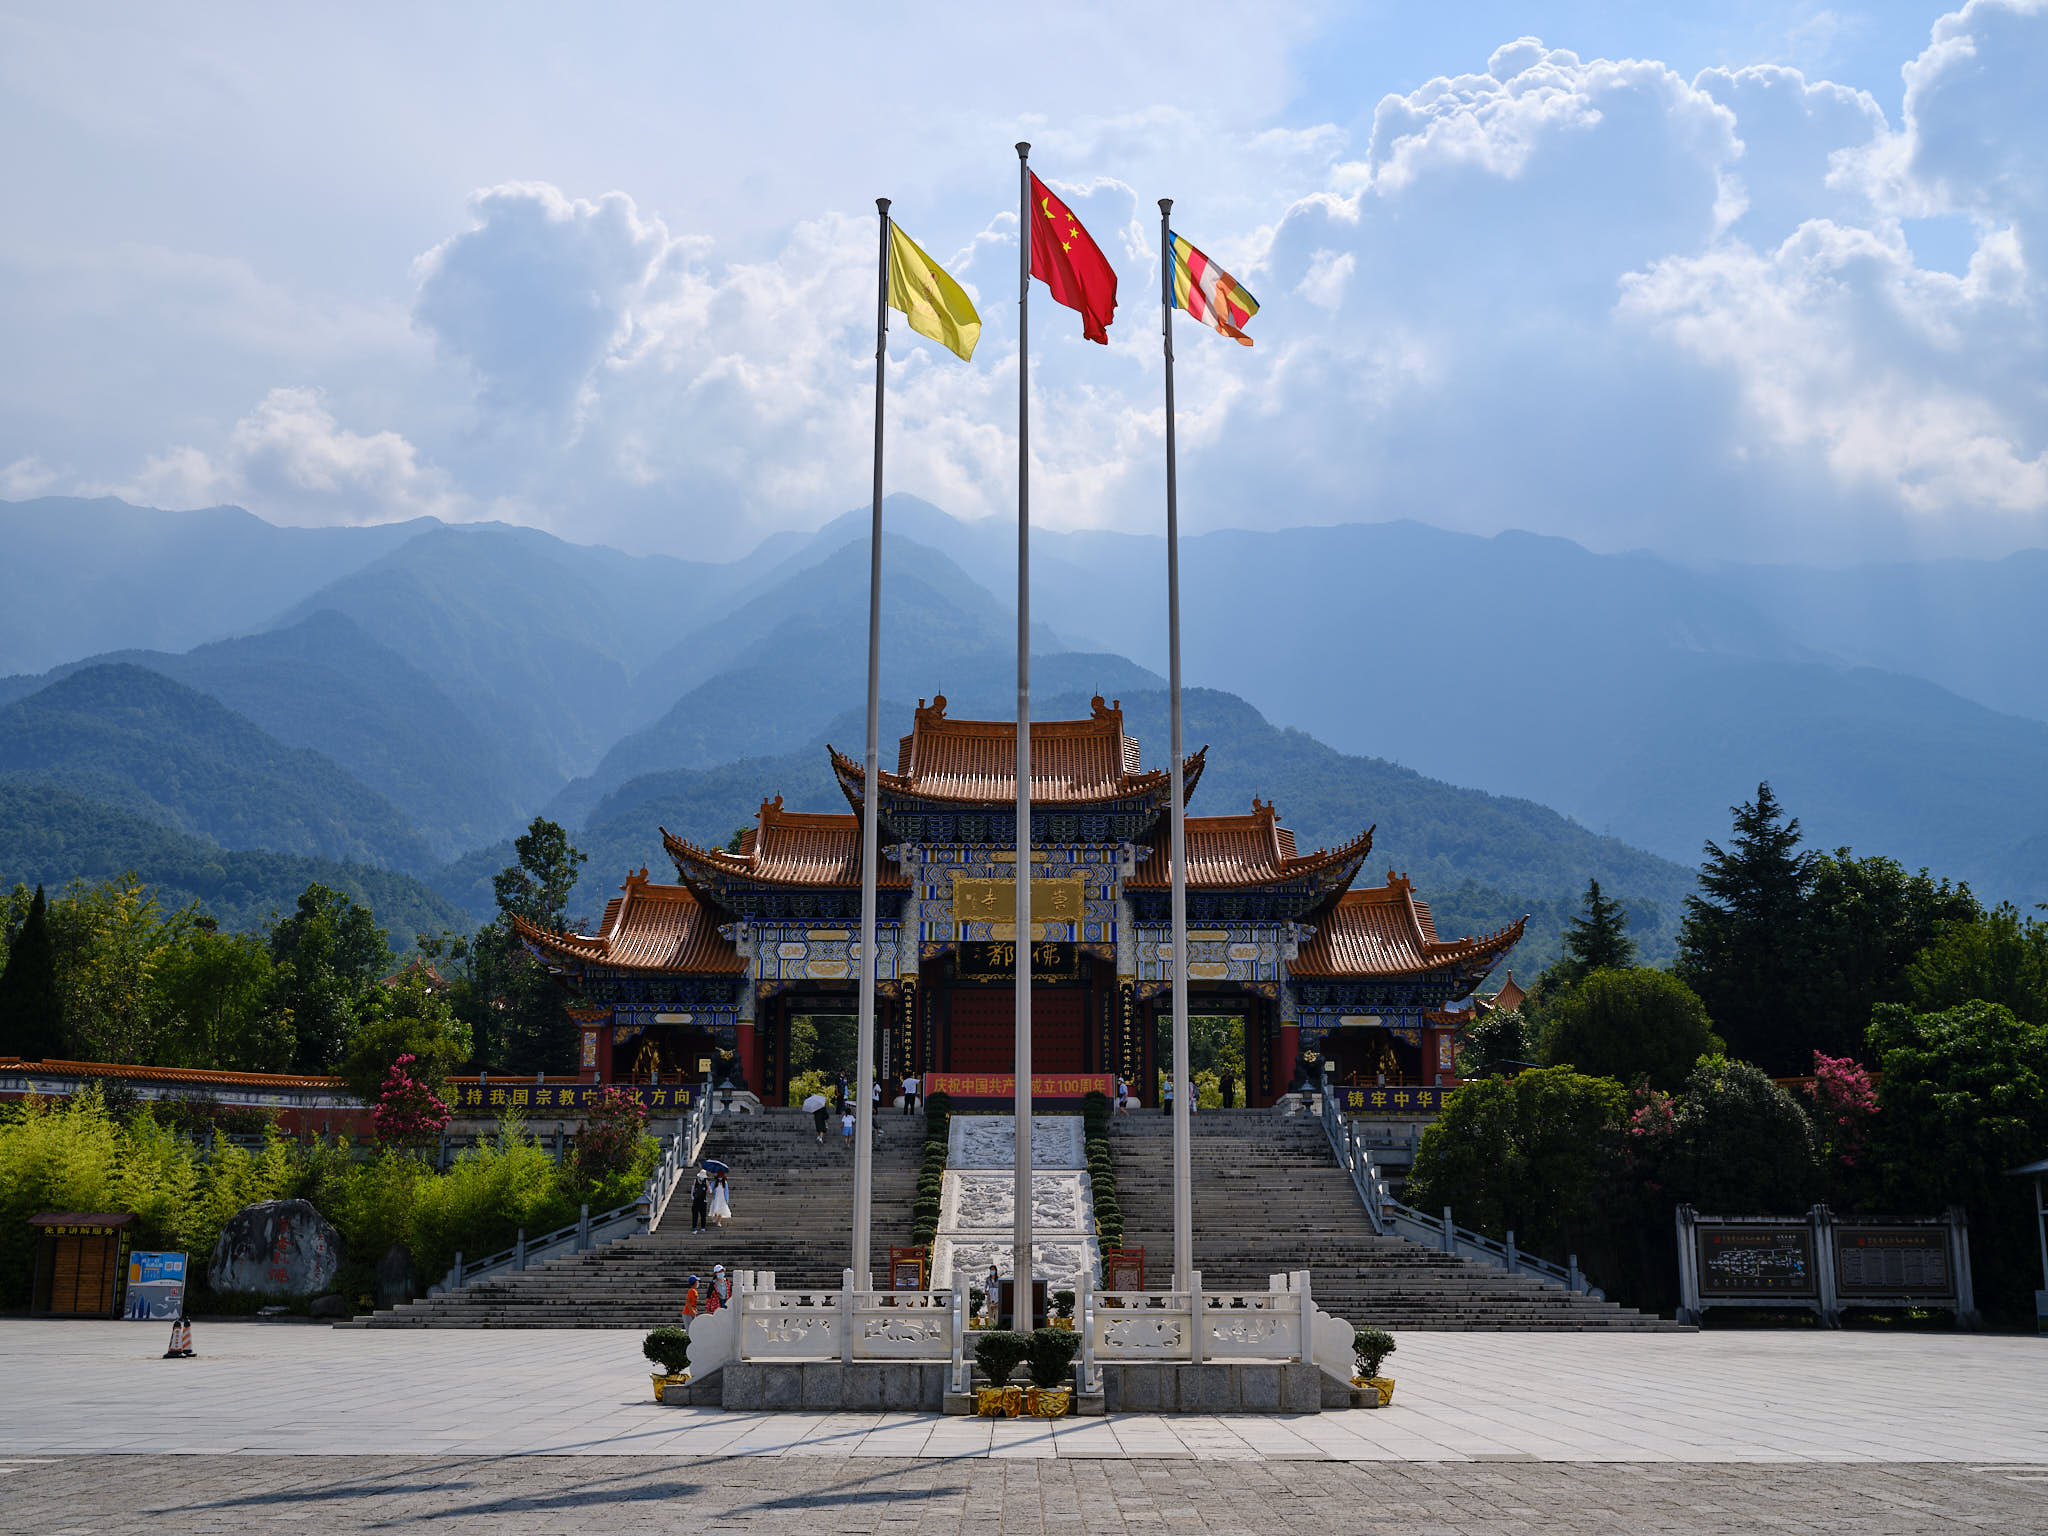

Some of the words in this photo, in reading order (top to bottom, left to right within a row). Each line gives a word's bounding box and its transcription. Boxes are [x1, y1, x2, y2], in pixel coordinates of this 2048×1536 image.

[981, 887, 1070, 911] 崇寺
[933, 1077, 1106, 1094] 庆祝中国共产成立100周年
